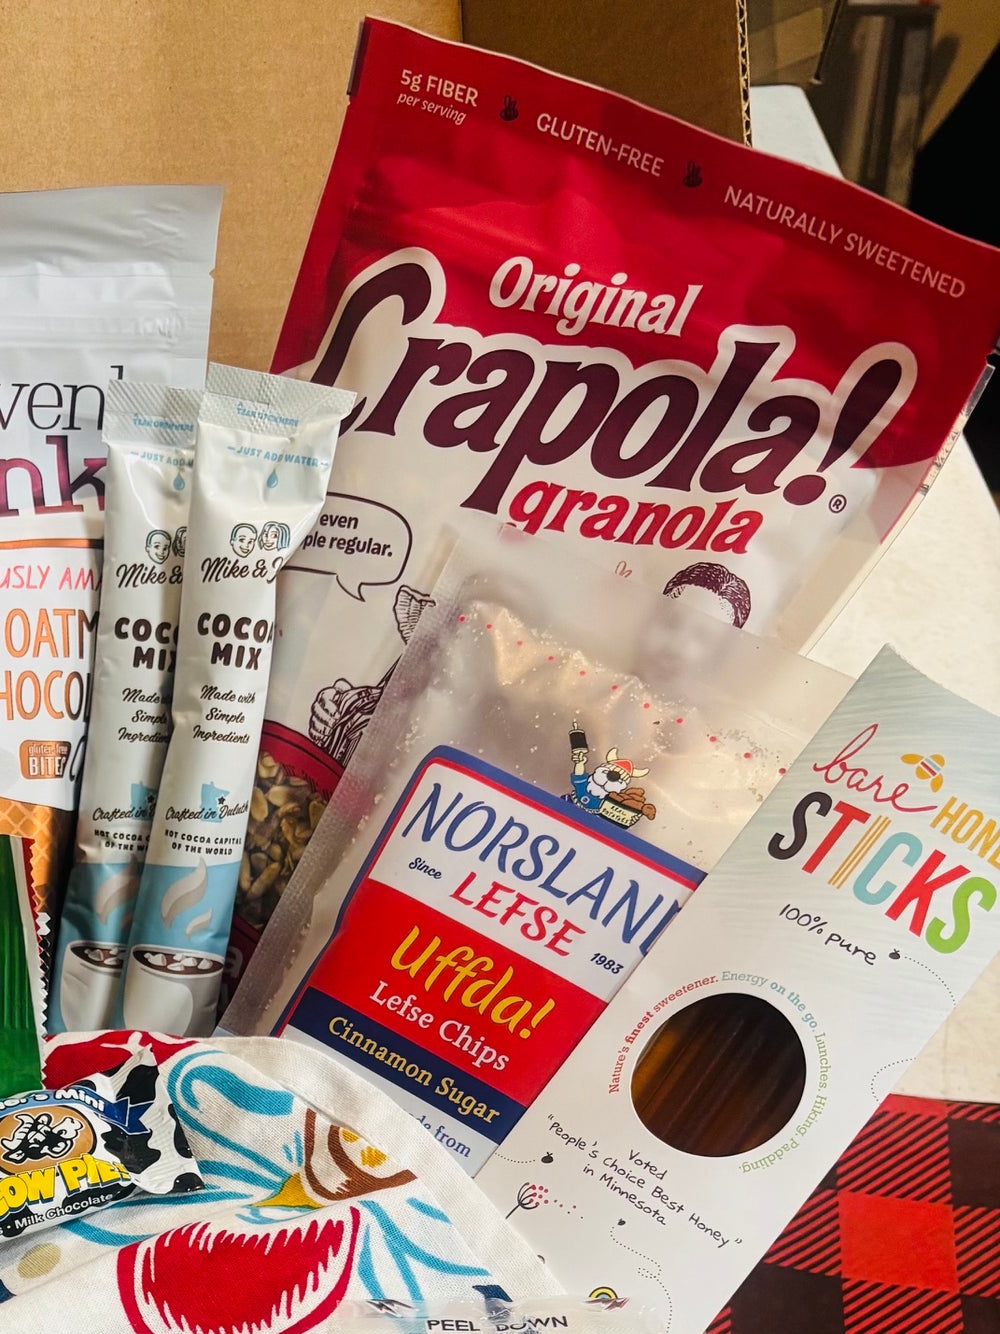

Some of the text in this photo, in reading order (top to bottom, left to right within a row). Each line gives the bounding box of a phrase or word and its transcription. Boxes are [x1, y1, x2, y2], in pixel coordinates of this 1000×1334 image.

[396, 92, 466, 126] per serving
[426, 76, 478, 107] FIBER
[536, 112, 664, 176] GLUTEN-FREE
[724, 186, 966, 298] NATURALLY SWEETENED
[488, 255, 702, 338] Original
[312, 261, 903, 513] Crapola!
[117, 563, 166, 588] Mike
[201, 558, 249, 584] Mike
[211, 642, 261, 671] MIX
[813, 724, 938, 812] bare
[768, 791, 997, 954] STICKS
[449, 872, 624, 974] LEFSE 1983
[779, 904, 876, 965] 100% pure
[389, 926, 556, 1040] Uffda!
[369, 980, 509, 1071] Lefse Chips
[608, 971, 831, 1093] Nature's finest sweetener. Energy the Lunches.
[54, 1088, 105, 1112] Mini
[329, 1016, 500, 1125] Cinnamon Sugar
[434, 1127, 472, 1158] from
[628, 1150, 667, 1180] Voted
[14, 1213, 44, 1230] Milk
[46, 1194, 114, 1221] Chocolate
[600, 1174, 666, 1226] Minnesota
[603, 1157, 684, 1213] Choice Best
